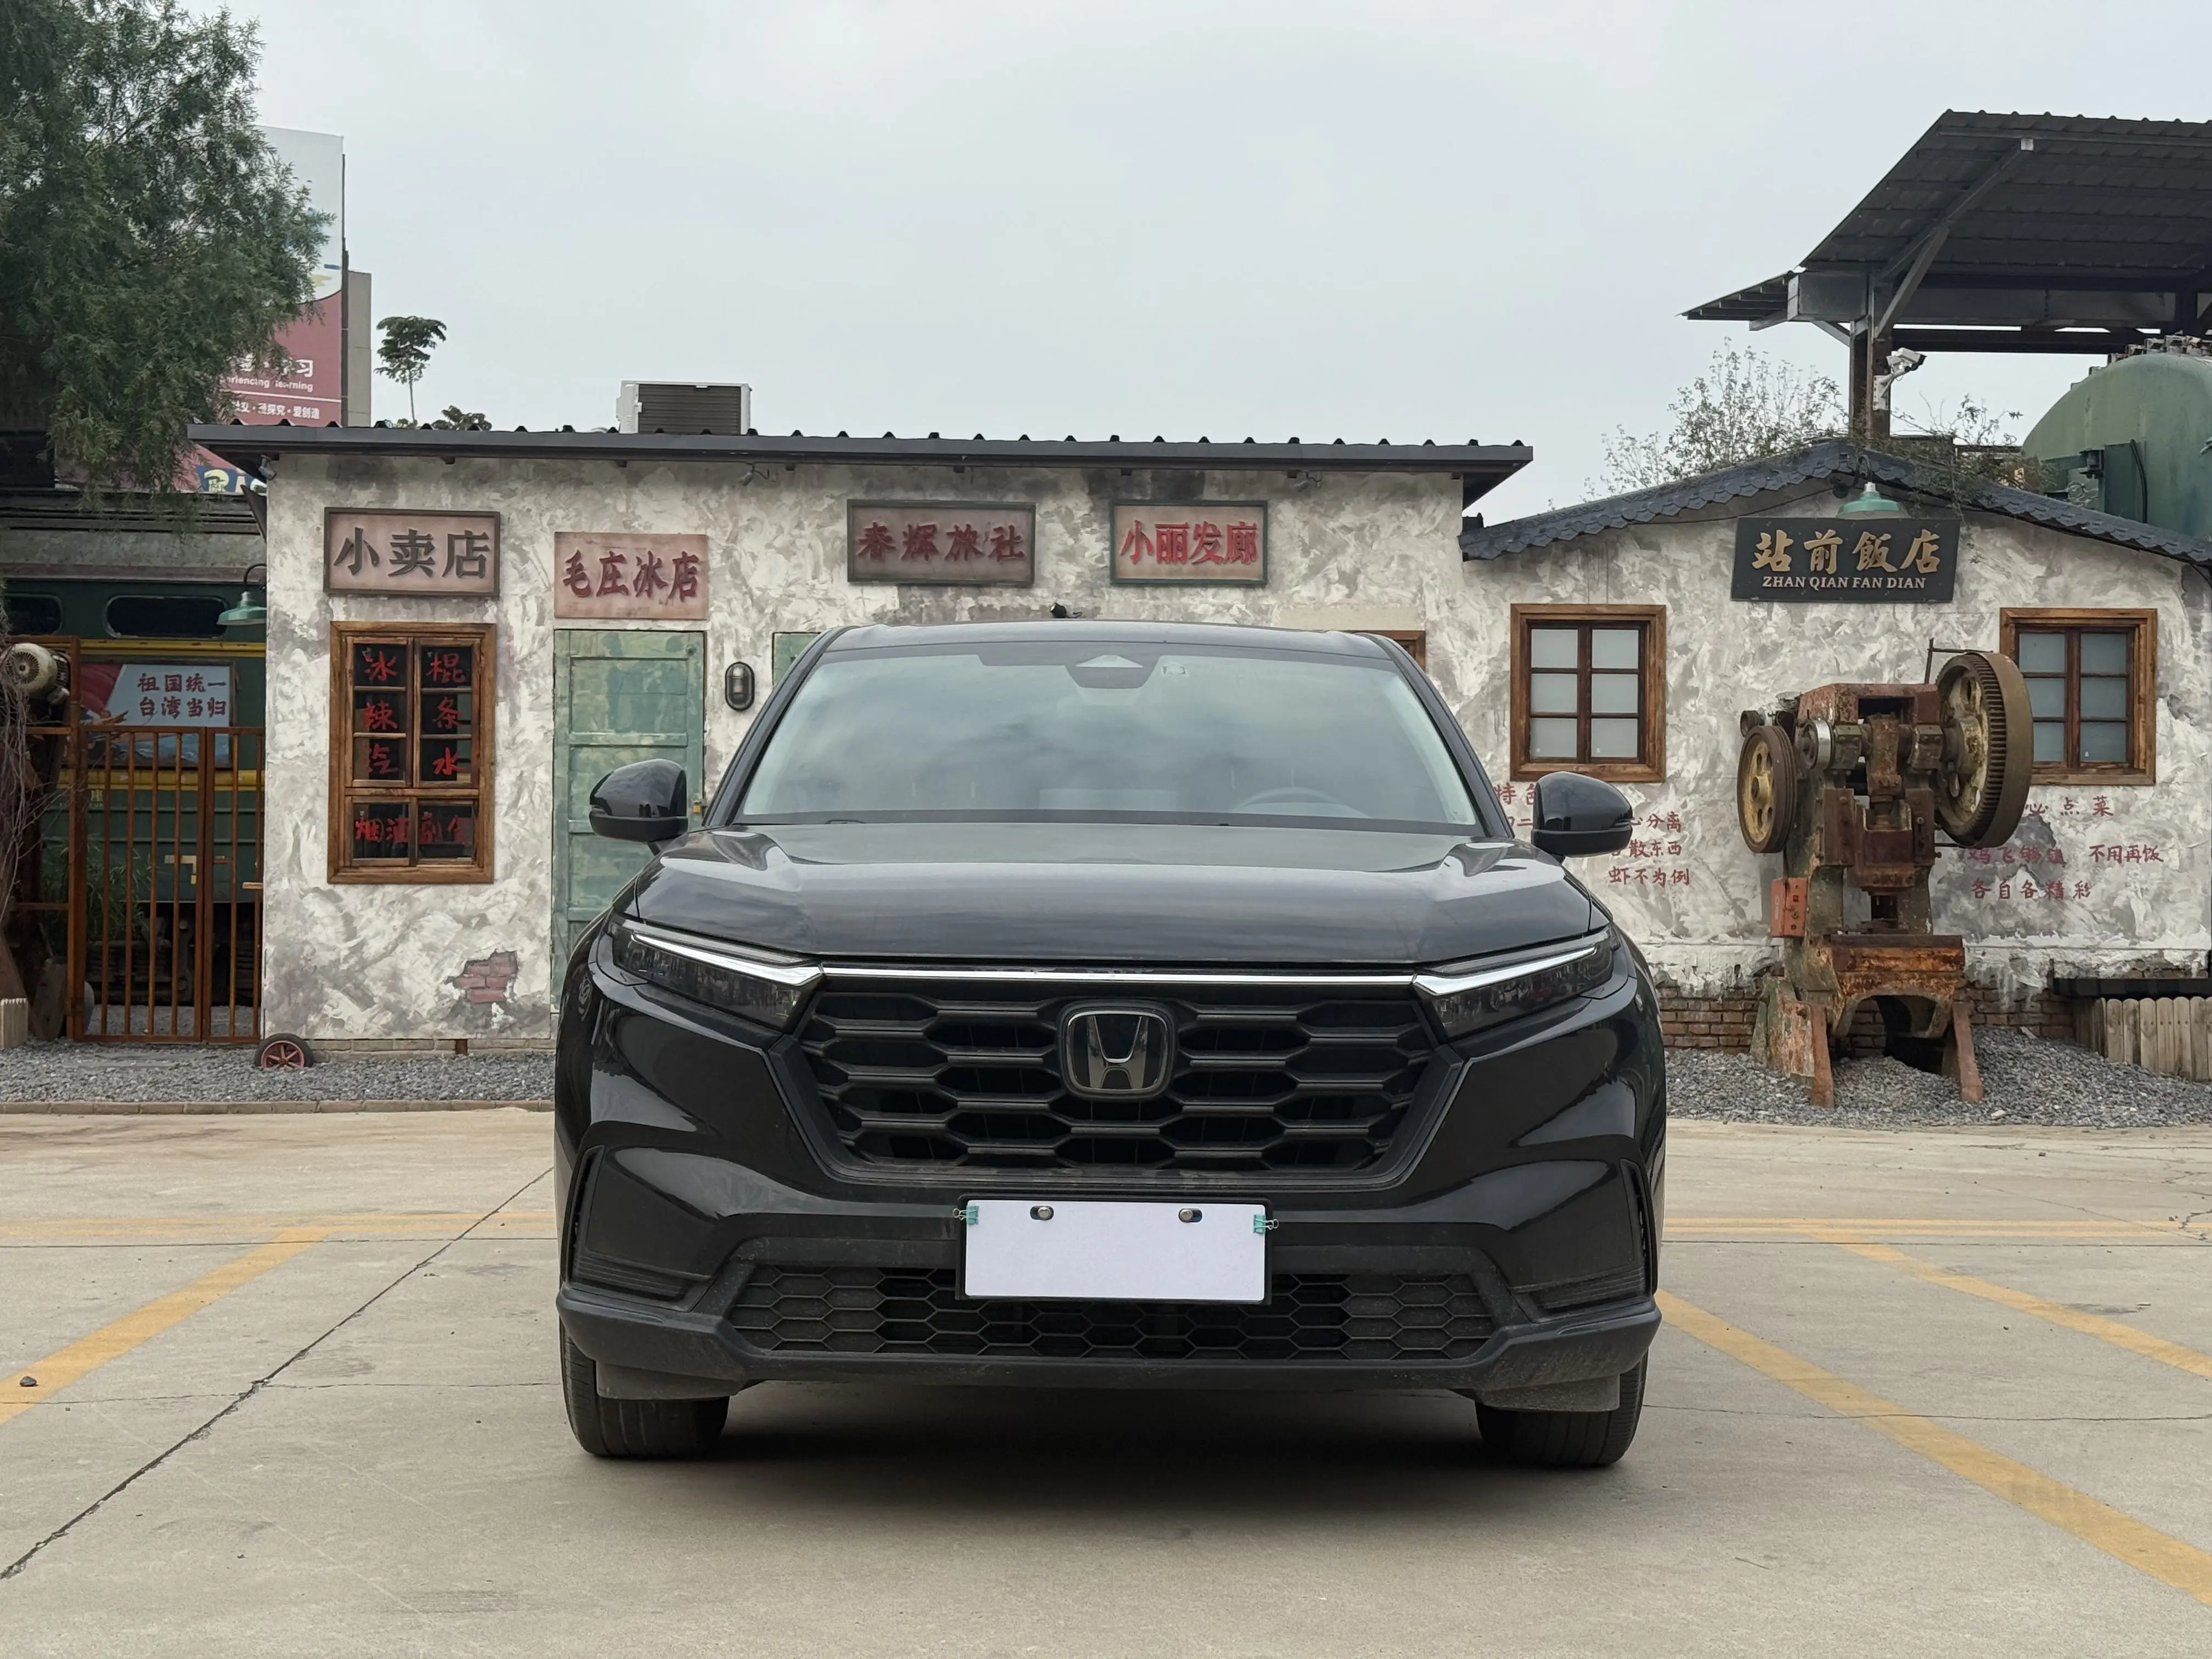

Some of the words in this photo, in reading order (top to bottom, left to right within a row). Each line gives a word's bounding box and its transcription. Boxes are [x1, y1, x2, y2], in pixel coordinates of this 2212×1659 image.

[856, 521, 1025, 562] 春辉旅社
[1119, 520, 1257, 565] 小丽发廊
[1752, 529, 1940, 574] 站前飯店
[334, 527, 490, 579] 小卖店
[562, 550, 699, 602] 毛庄冰店
[1762, 576, 1807, 588] ZHAN
[1809, 576, 1849, 591] QIAN
[1852, 577, 1883, 589] FAN
[1886, 577, 1926, 589] DIAN
[138, 673, 227, 692] 祖国统一
[139, 696, 227, 719] 台湾当归
[2025, 795, 2114, 817] 必点菜
[2089, 844, 2164, 865] 不用再饭
[1608, 866, 1690, 887] 虾不为例
[1971, 878, 2091, 900] 各自各精彩
